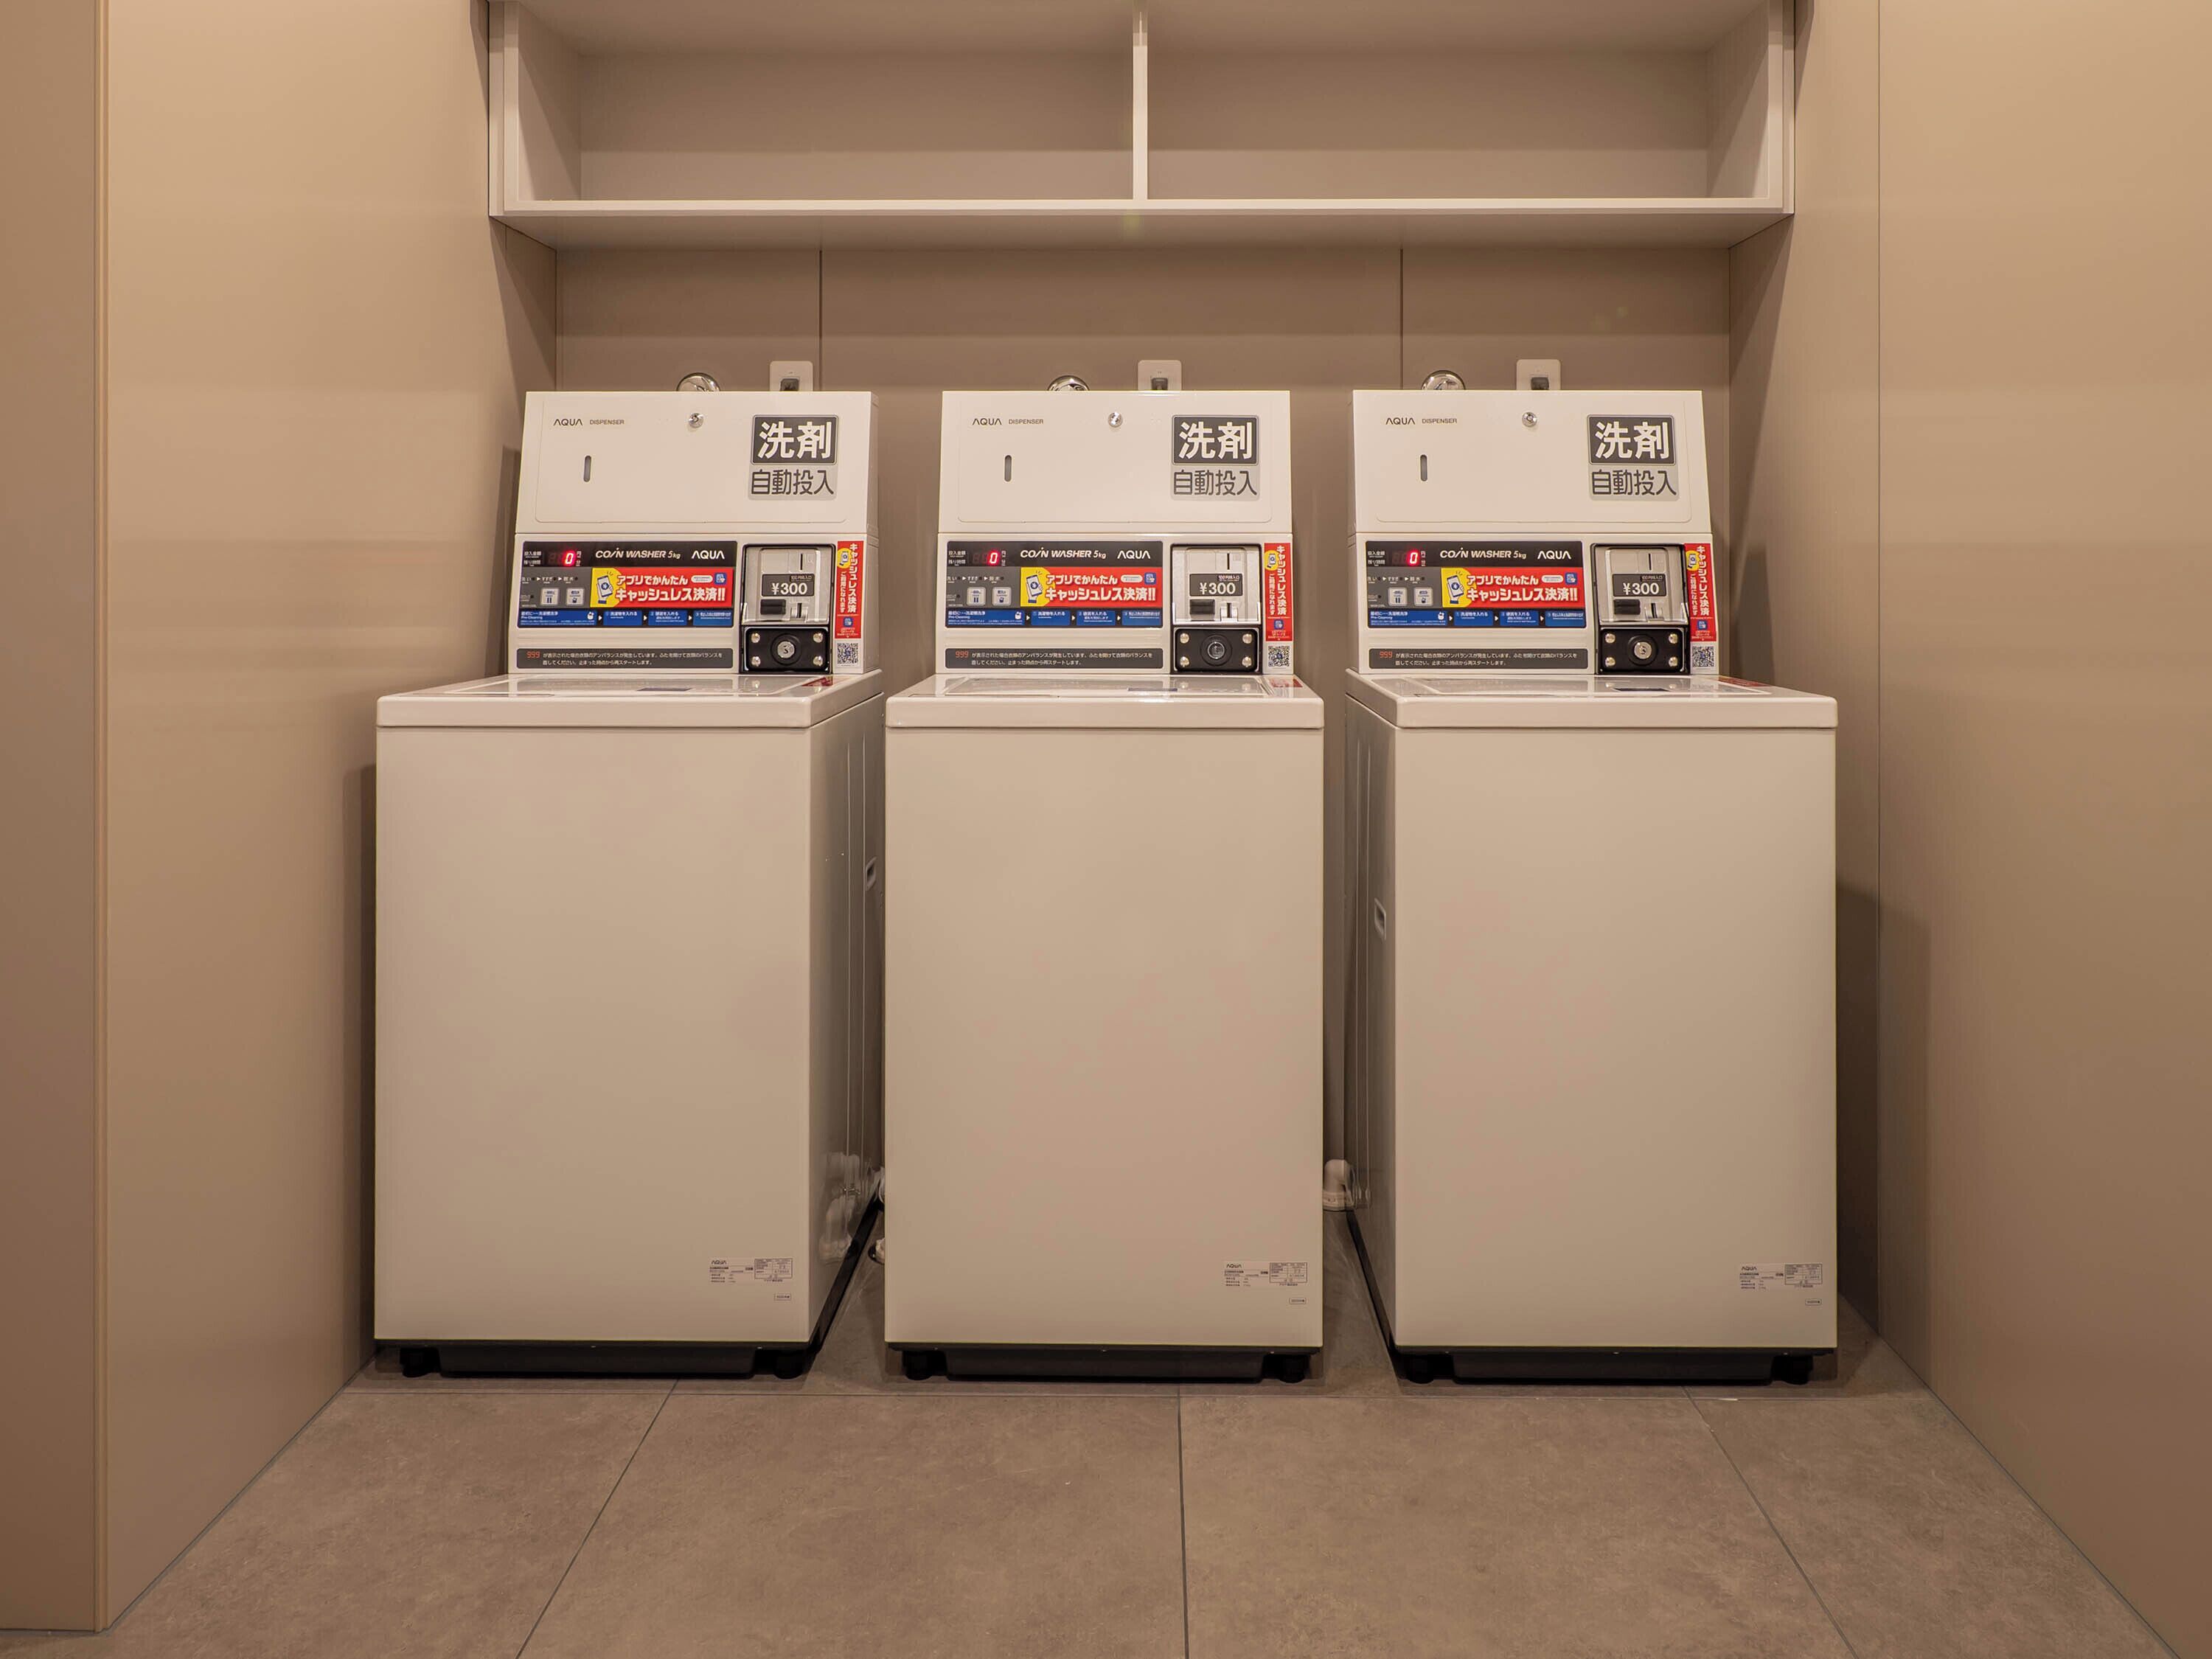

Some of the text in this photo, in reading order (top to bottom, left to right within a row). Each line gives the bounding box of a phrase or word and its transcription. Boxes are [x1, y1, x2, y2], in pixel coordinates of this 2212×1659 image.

[972, 417, 1003, 425] AQUA
[1385, 417, 1416, 425] AQUA
[757, 421, 832, 459] 洗剤
[1178, 421, 1253, 459] 洗剤
[1595, 421, 1669, 459] 洗剤
[751, 469, 834, 495] 自動投入
[1173, 470, 1257, 495] 自動投入
[1591, 470, 1677, 495] 自動投入
[565, 553, 574, 565] 0
[667, 551, 681, 559] 5kg
[692, 550, 725, 560] AQUA
[990, 552, 998, 564] 0
[1051, 550, 1092, 558] WASHER
[1093, 550, 1107, 560] 5kg
[1117, 550, 1151, 560] AQUA
[1409, 552, 1418, 564] 0
[1513, 551, 1526, 560] 5kg
[1537, 550, 1571, 560] AQUA
[617, 575, 689, 585] アプリでかんたん
[847, 543, 858, 613] キャッシュレス決済
[1046, 575, 1118, 585] アプリでかんたん
[1276, 546, 1287, 616] キャッシュレス決済
[1467, 575, 1538, 585] アプリでかんたん
[1696, 546, 1710, 616] キャッシュレス決済
[772, 582, 807, 595] ¥300
[1200, 582, 1236, 595] ¥300
[1623, 582, 1659, 595] ¥300
